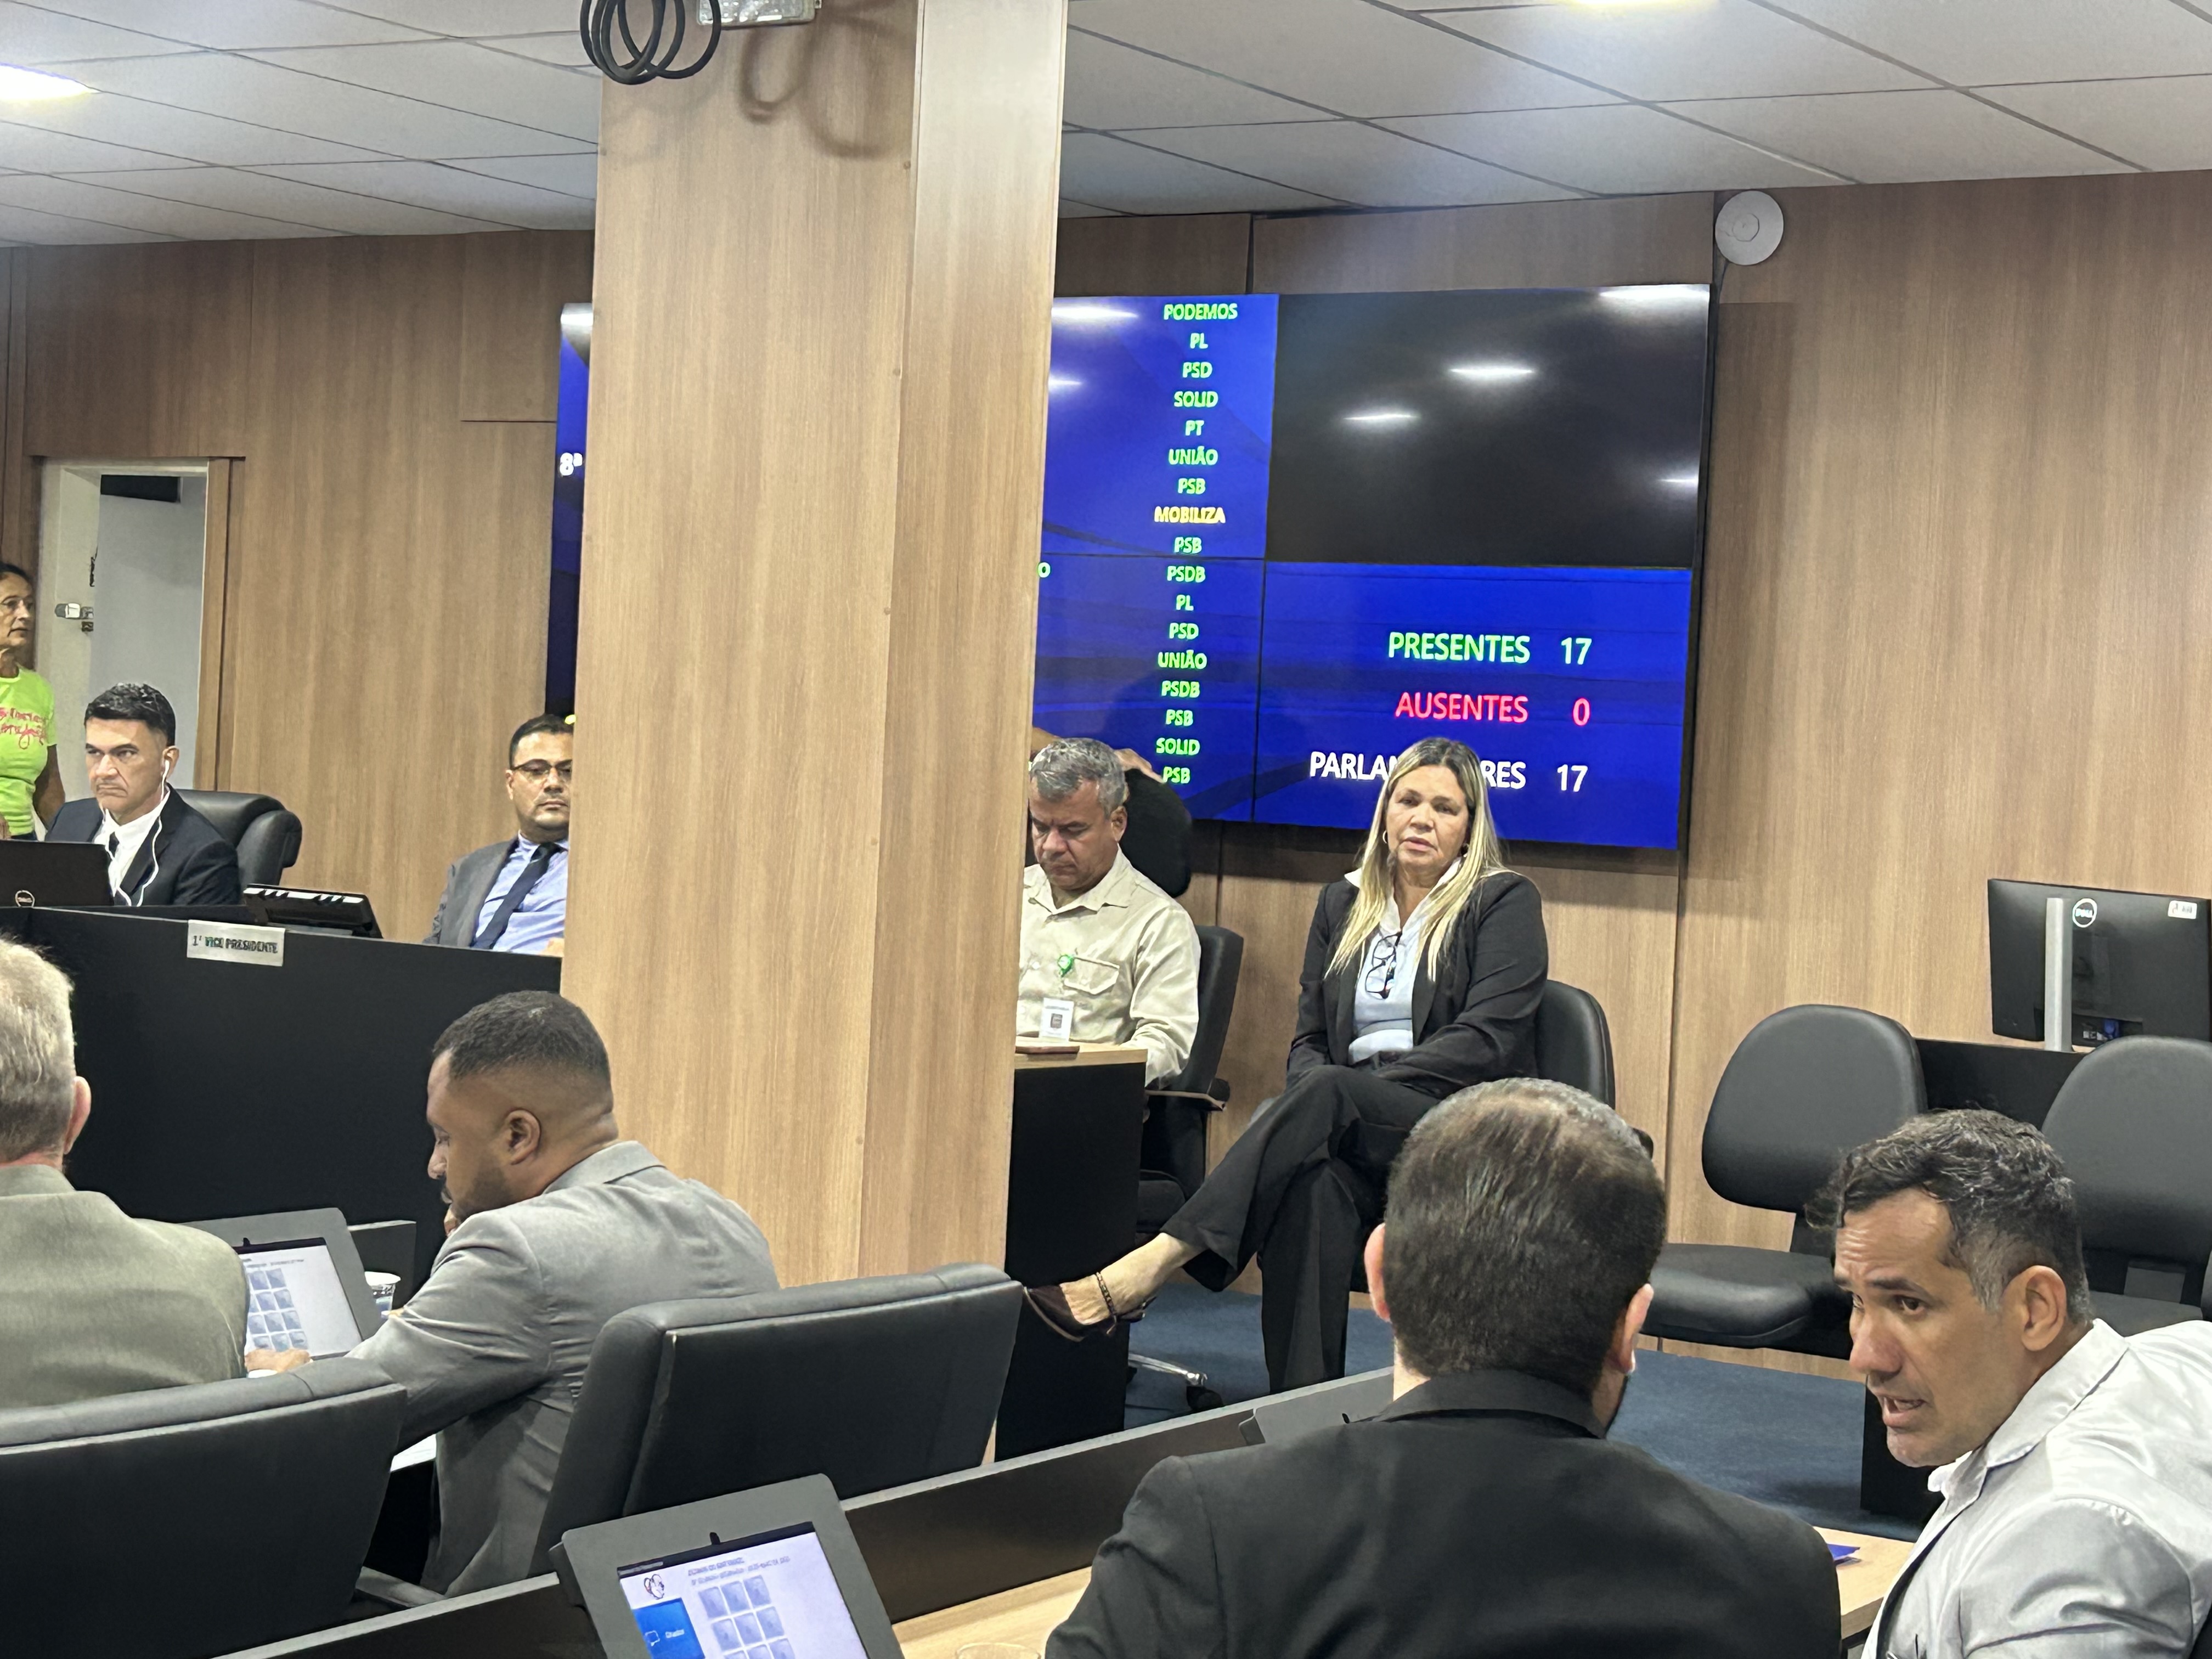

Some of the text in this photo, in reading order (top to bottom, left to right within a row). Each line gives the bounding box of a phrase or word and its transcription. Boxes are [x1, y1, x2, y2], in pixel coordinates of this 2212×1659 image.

[1164, 303, 1238, 320] PODEMOS
[1189, 332, 1209, 349] PL
[1182, 362, 1213, 379] PSD
[1173, 391, 1219, 408] SOLID
[1184, 420, 1205, 436] PT
[1168, 445, 1218, 465] UNIÃO
[1177, 477, 1206, 494] PSB
[1154, 506, 1226, 524] MOBILIZA
[1173, 537, 1203, 554] PSB
[1166, 565, 1206, 583] PSDB
[1175, 594, 1194, 611] PL
[1169, 622, 1199, 640] PSD
[1388, 631, 1592, 665] PRESENTES 17
[1157, 649, 1207, 670] UNIÃO
[1161, 680, 1200, 698] PSDB
[1165, 709, 1194, 727] PSB
[1395, 692, 1590, 726] AUSENTES 0
[1156, 737, 1200, 755] SOLID
[1163, 766, 1190, 784] PSB
[1310, 751, 1588, 793] PARLARES 17
[225, 938, 278, 953] PRESIDENTE
